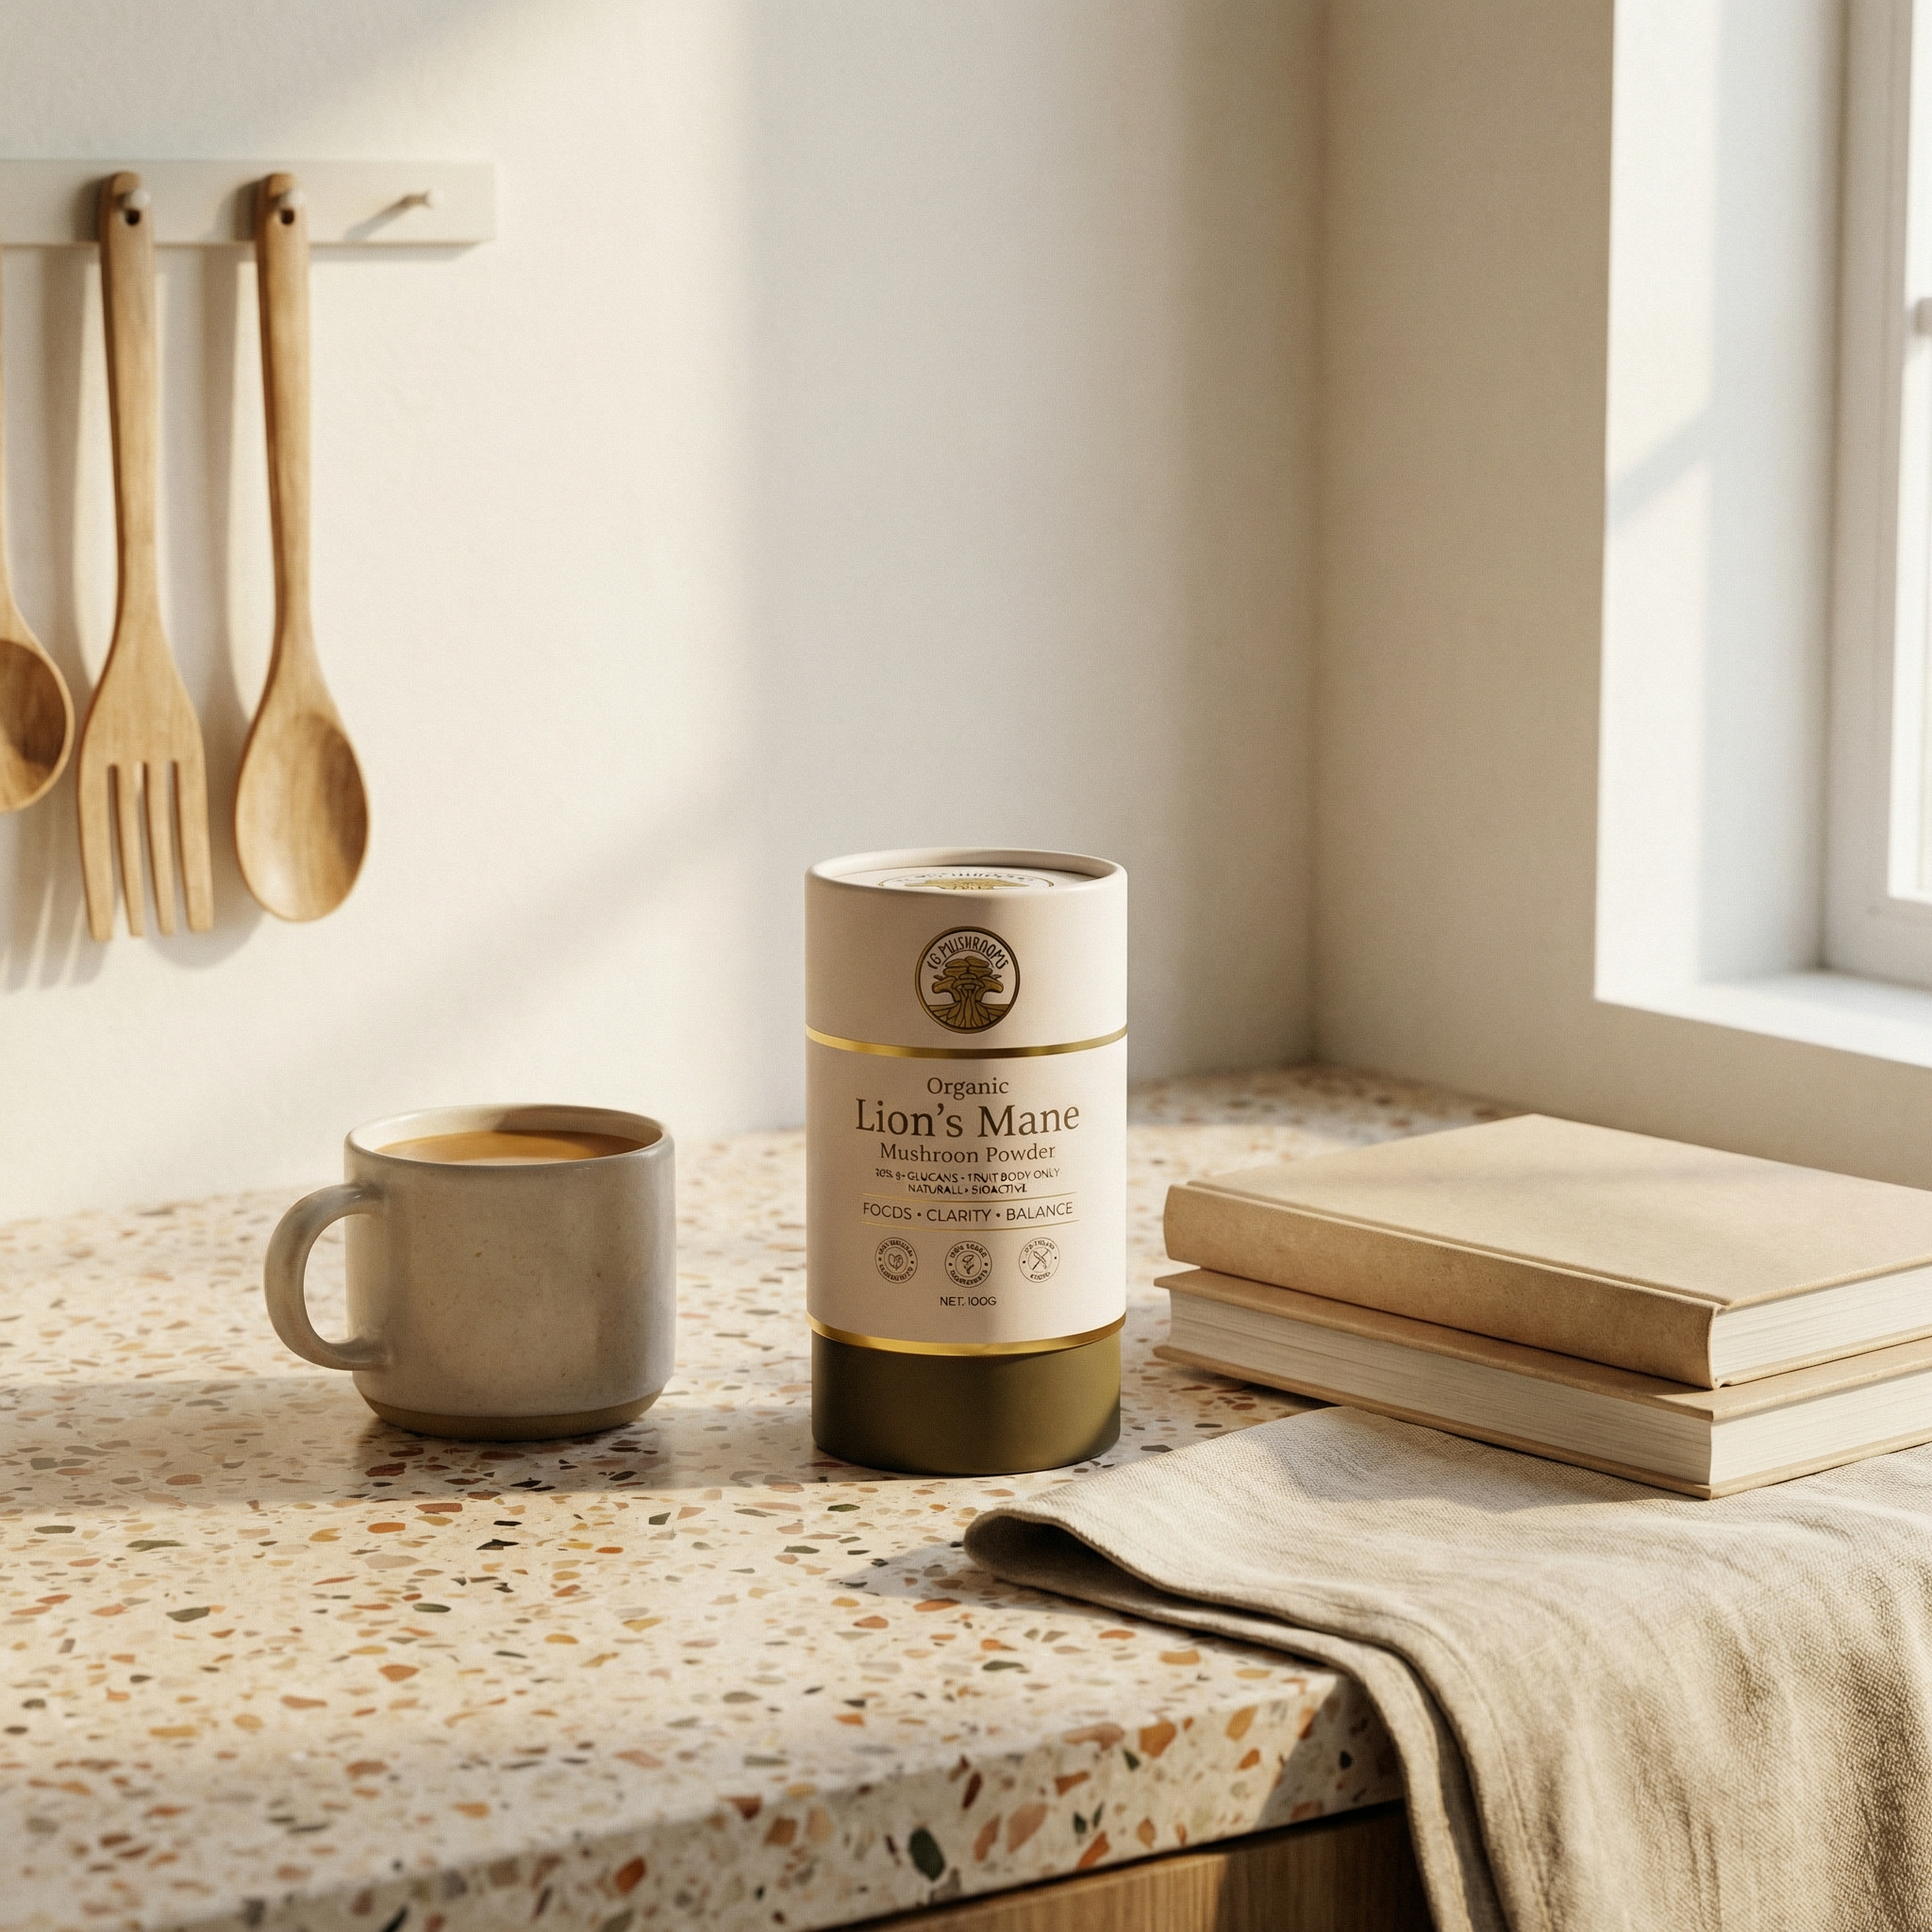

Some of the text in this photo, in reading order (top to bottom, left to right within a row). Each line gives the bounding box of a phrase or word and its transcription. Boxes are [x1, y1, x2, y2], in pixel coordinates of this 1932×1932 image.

[926, 1077, 1009, 1100] Organic
[856, 1097, 1079, 1138] Lion's Mane
[986, 1142, 1056, 1163] Powder
[1001, 1171, 1031, 1182] BODY
[1033, 1168, 1060, 1179] ONLY
[926, 1208, 991, 1223] CLARITY
[1007, 1201, 1074, 1221] BALANCE
